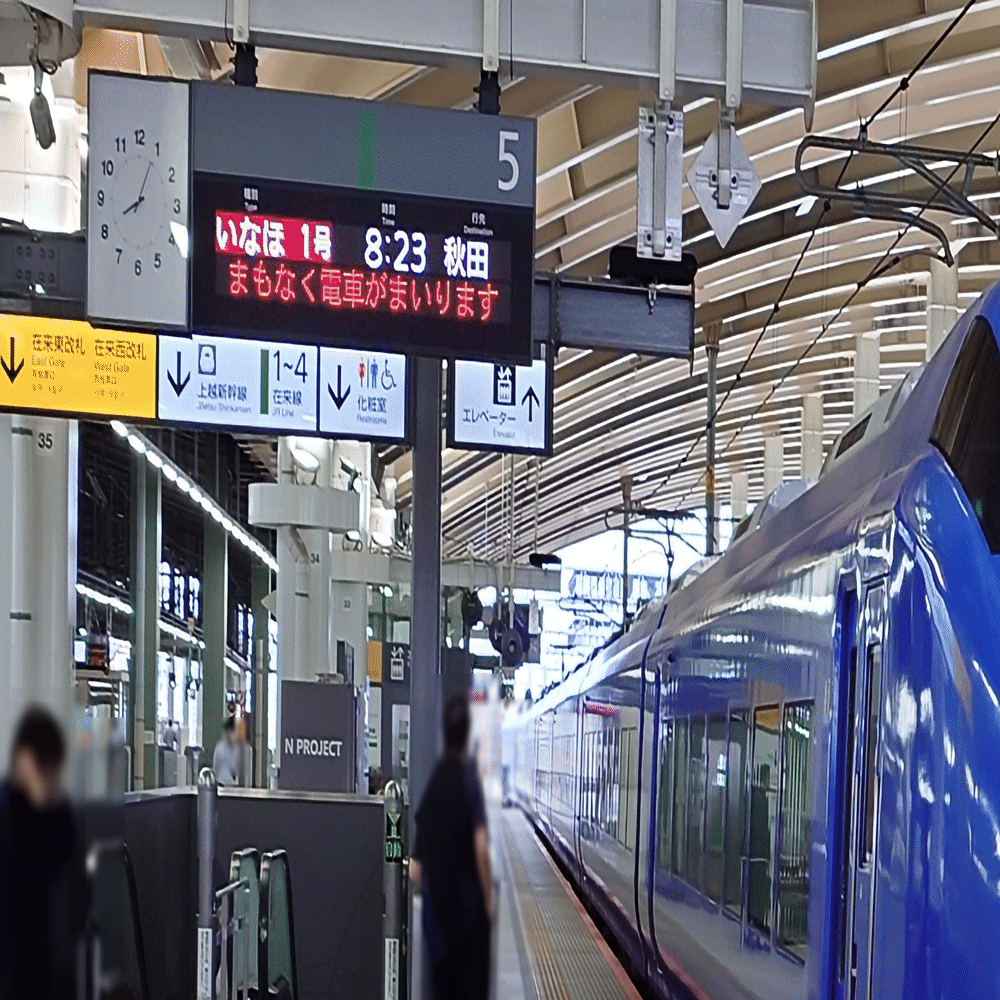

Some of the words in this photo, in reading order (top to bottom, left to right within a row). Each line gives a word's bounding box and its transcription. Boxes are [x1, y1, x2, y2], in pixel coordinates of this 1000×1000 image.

[115, 137, 126, 153] 11
[134, 129, 146, 146] 12
[155, 142, 160, 157] 1
[101, 160, 114, 176] 10
[498, 130, 520, 191] 5
[168, 167, 176, 183] 2
[97, 190, 105, 207] 9
[173, 198, 181, 214] 3
[101, 224, 109, 240] 8
[216, 216, 285, 258] いなほ
[301, 223, 332, 262] 1号
[115, 248, 123, 264] 7
[364, 227, 427, 274] 8:23
[443, 236, 489, 280] 秋田
[134, 260, 142, 276] 6
[154, 253, 162, 269] 5
[229, 260, 499, 321] まもなく電車がまいります
[462, 408, 517, 425] エレベーター
[38, 432, 53, 450] 35
[310, 553, 320, 564] 34
[284, 738, 294, 755] N
[296, 738, 343, 757] PROJECT
